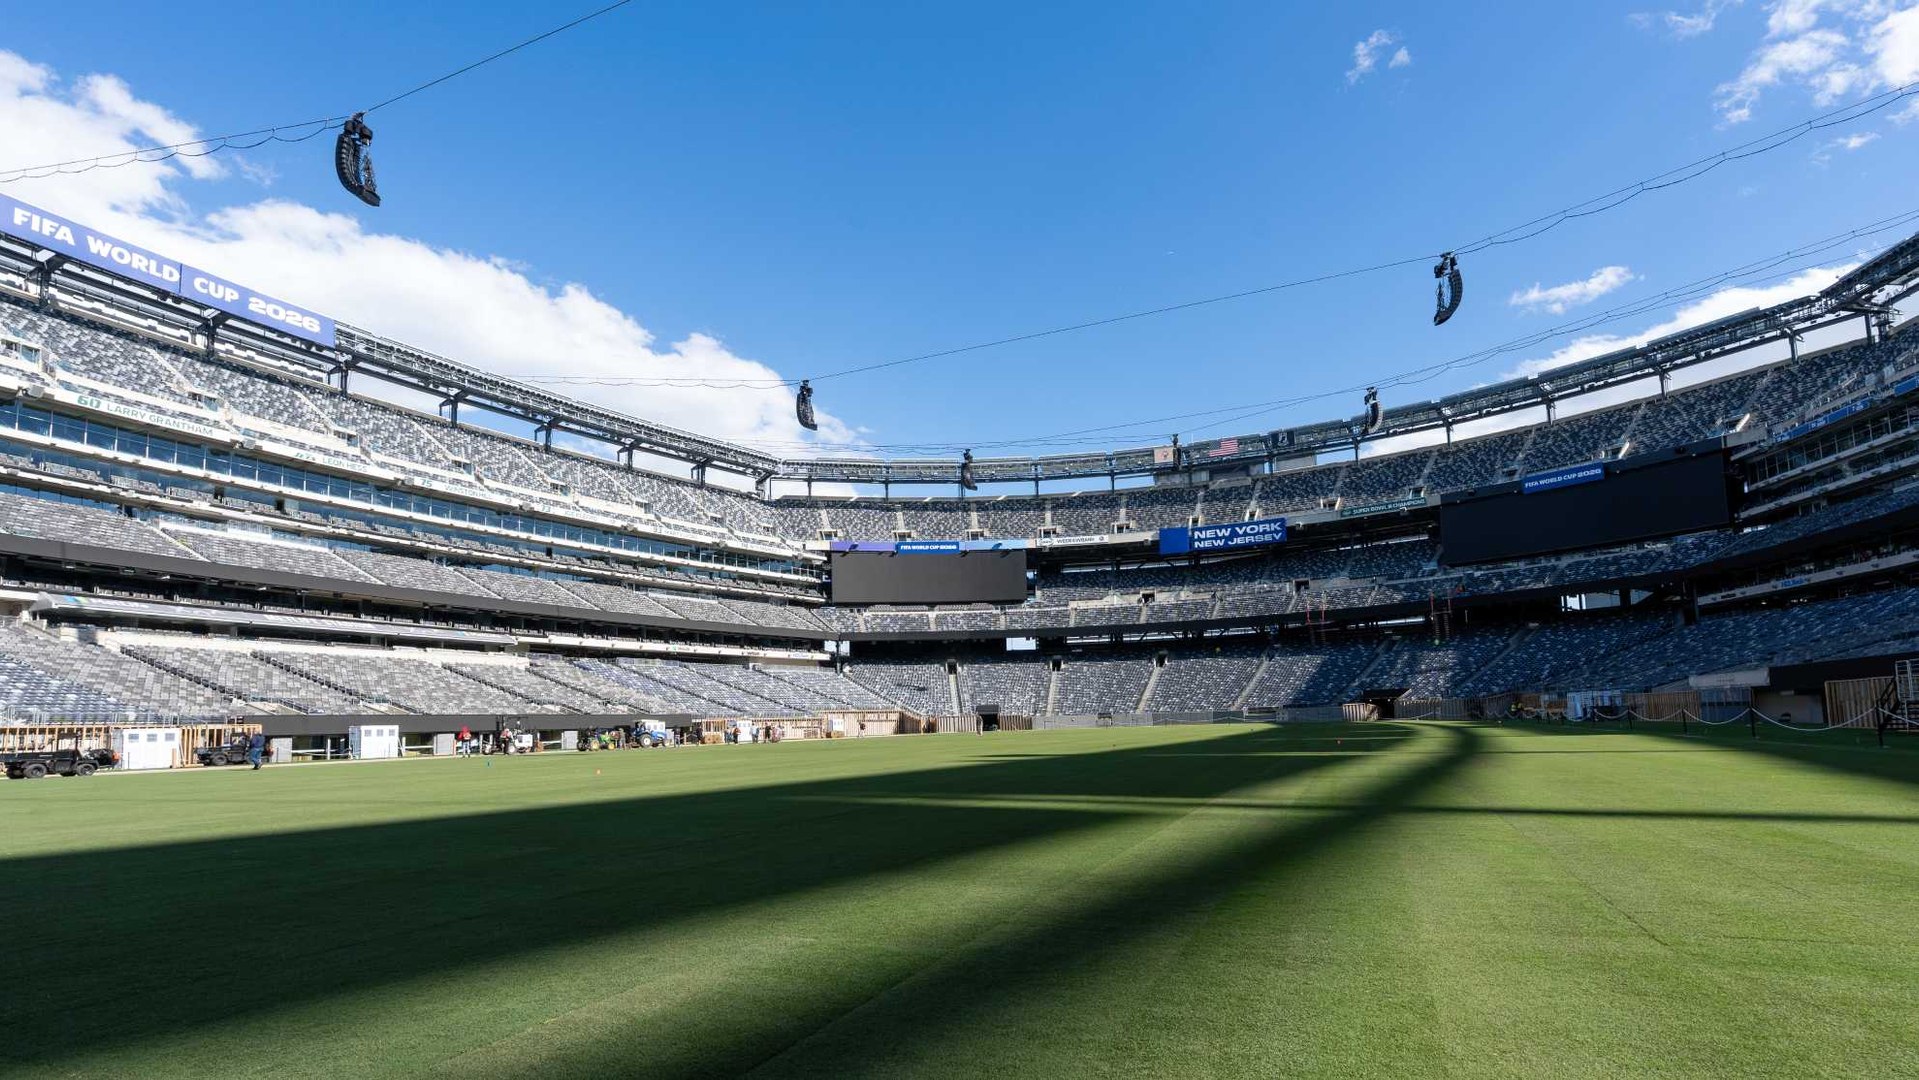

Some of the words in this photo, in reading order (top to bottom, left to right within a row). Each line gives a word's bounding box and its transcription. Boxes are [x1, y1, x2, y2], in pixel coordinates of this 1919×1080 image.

[14, 207, 76, 246] FIFA
[87, 235, 181, 283] WORLD
[193, 277, 239, 303] CUP
[248, 297, 321, 333] 2026
[77, 395, 101, 411] 60
[107, 403, 146, 421] LARRY
[149, 412, 213, 437] GRANTHAM
[1539, 476, 1563, 485] WORLD
[1194, 527, 1231, 539] NEW
[1235, 521, 1282, 536] YORK
[1194, 538, 1225, 548] NEW
[1228, 532, 1282, 545] JERSEY
